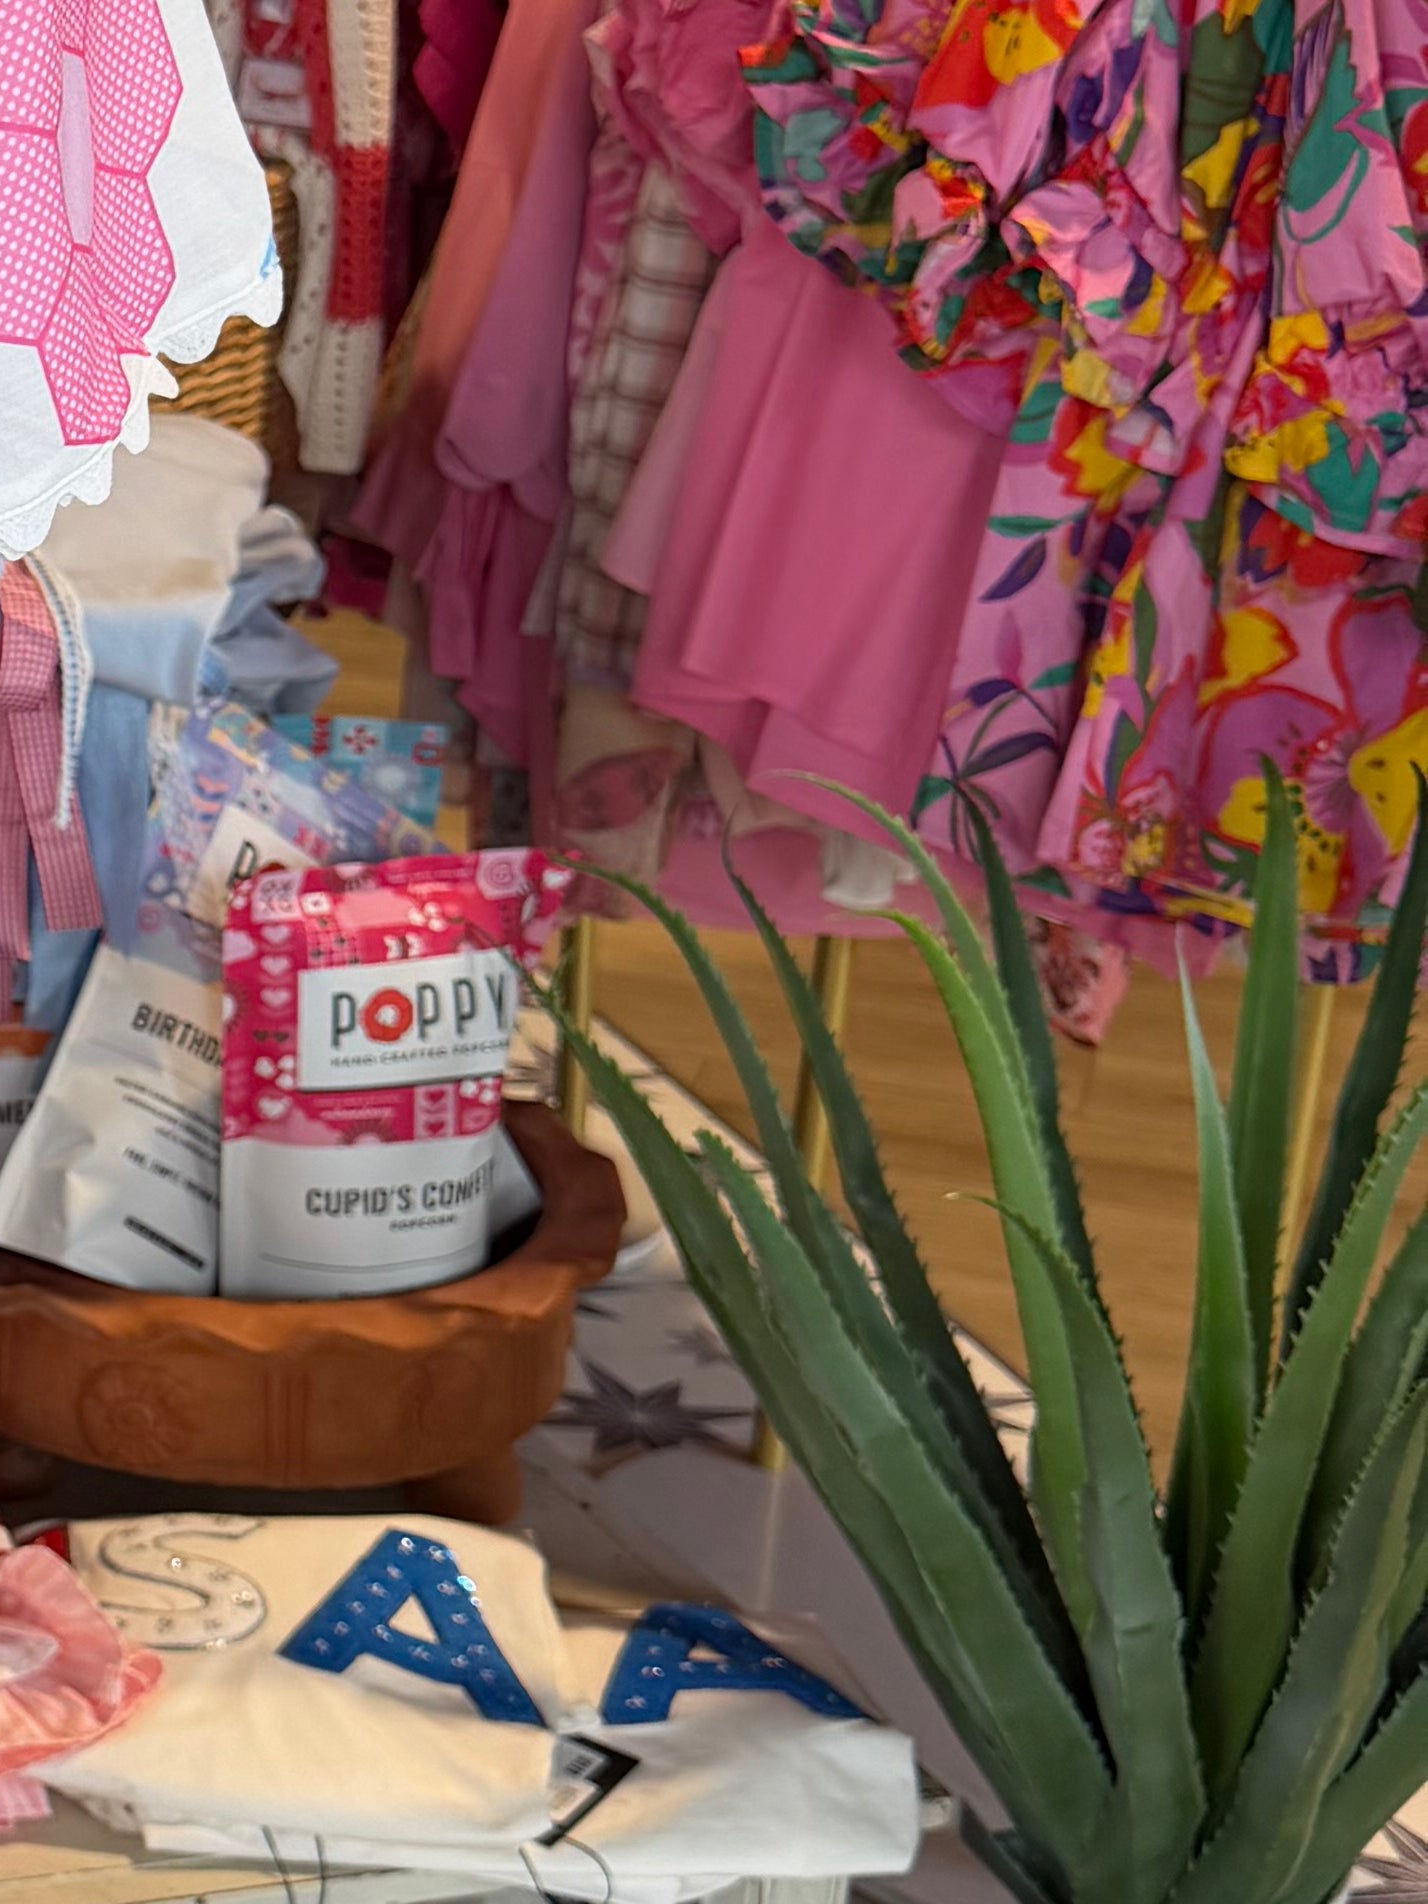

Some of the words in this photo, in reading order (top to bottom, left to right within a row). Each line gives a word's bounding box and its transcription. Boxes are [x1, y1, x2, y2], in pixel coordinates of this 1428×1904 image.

[131, 1002, 223, 1068] BIRTHD
[330, 971, 507, 1050] POPPY
[305, 1182, 412, 1217] CUPID'S
